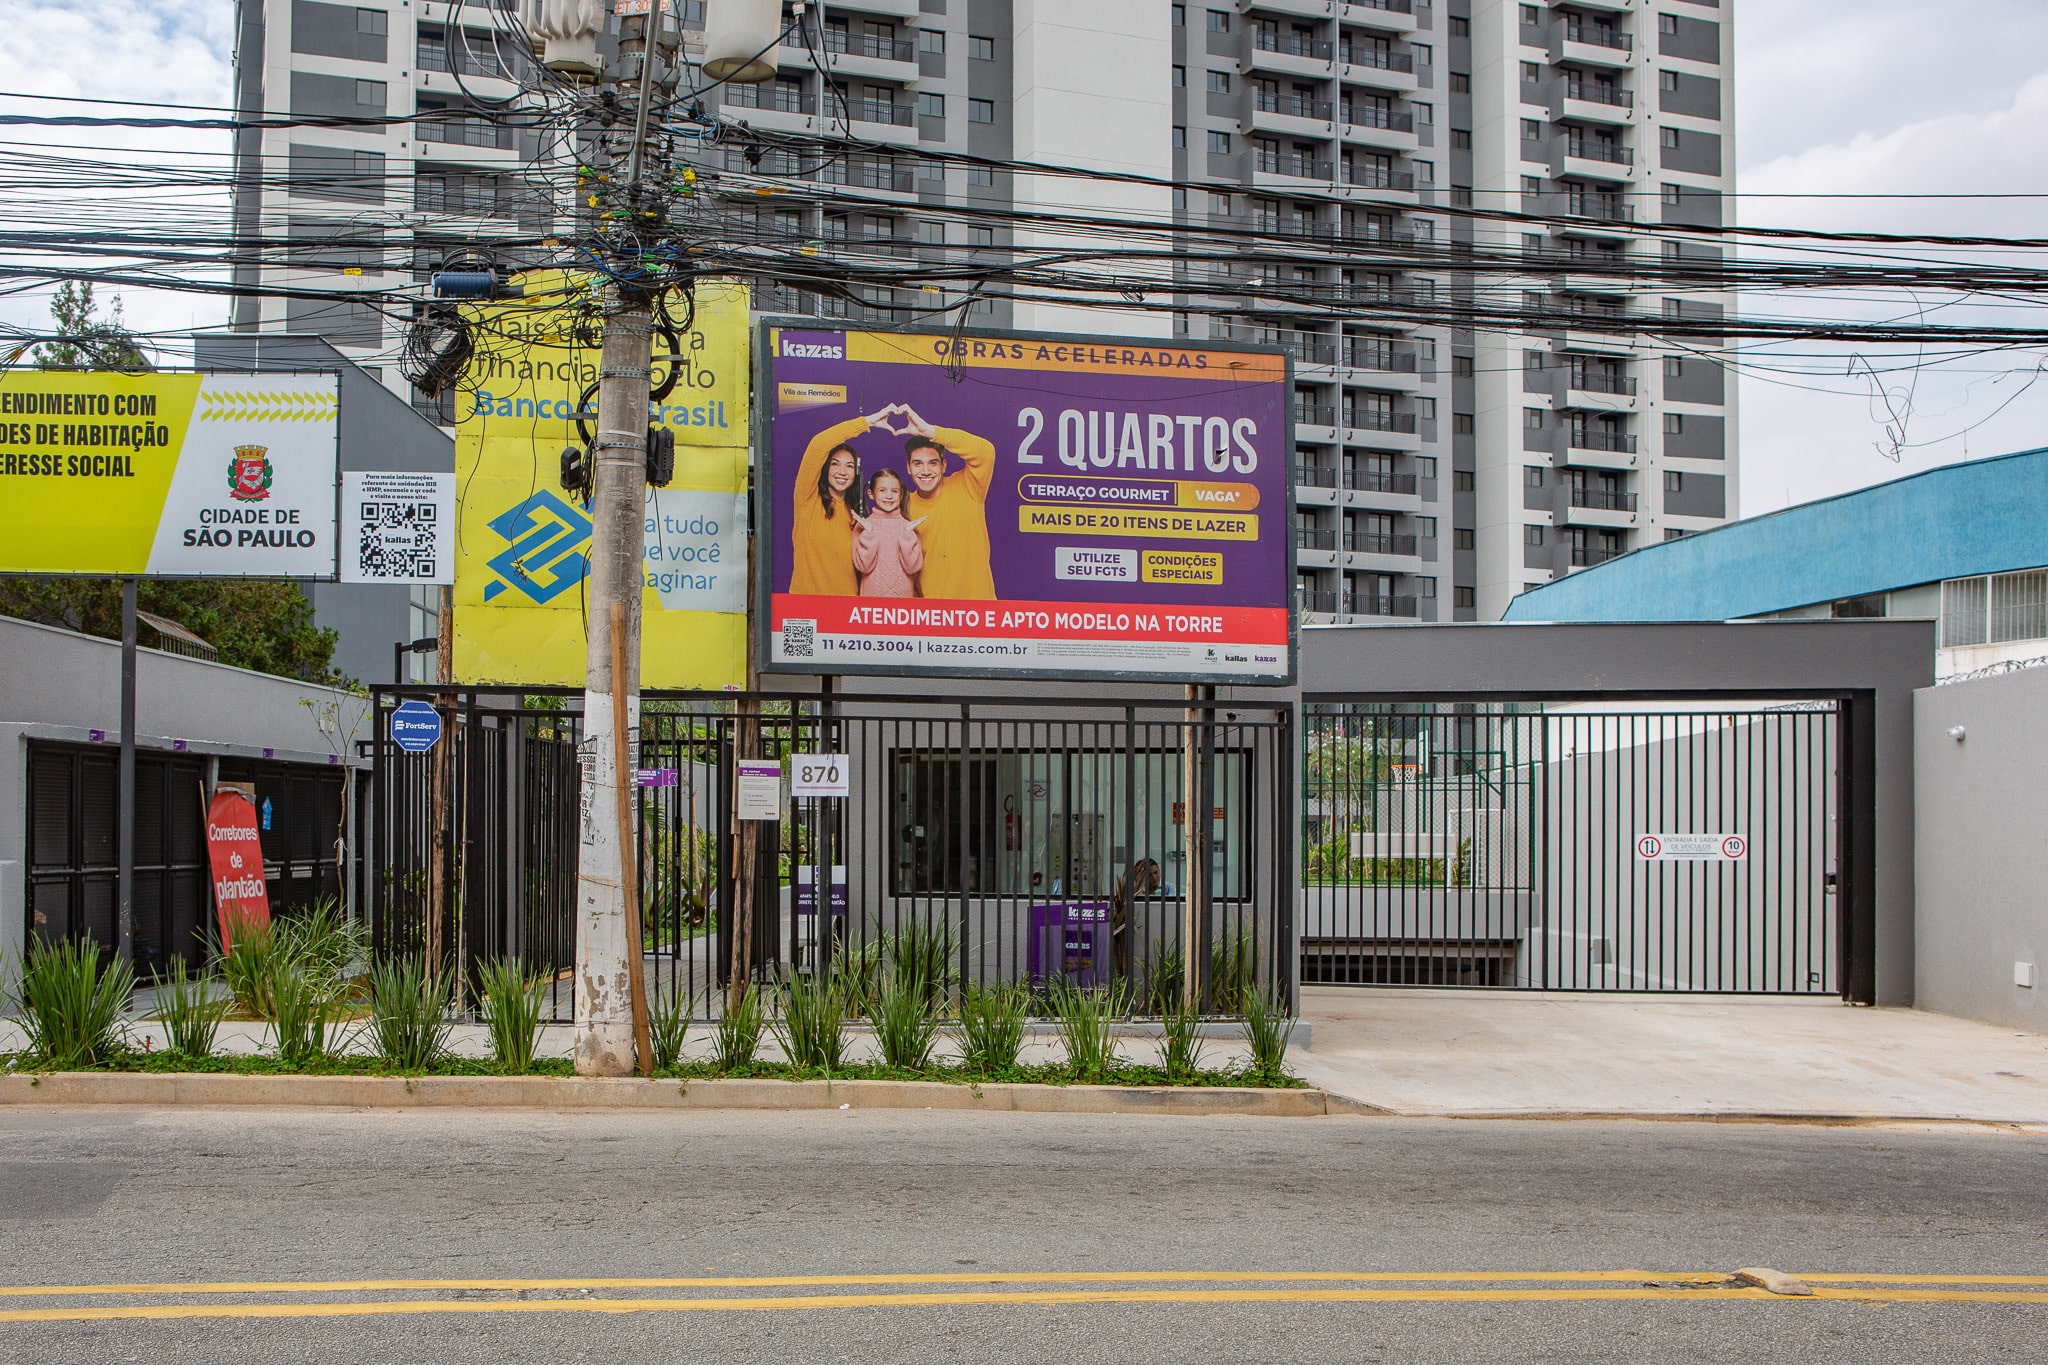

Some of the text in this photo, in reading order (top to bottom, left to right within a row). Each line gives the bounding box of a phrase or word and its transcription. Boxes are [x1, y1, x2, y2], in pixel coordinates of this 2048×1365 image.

[782, 339, 842, 359] kazzas
[933, 340, 1209, 370] OBRAS ACELERADAS
[475, 350, 598, 382] financia
[808, 388, 840, 397] Remédios
[0, 392, 156, 416] ENDIMENTO COM
[475, 390, 574, 420] Banco
[36, 424, 59, 445] DE
[64, 421, 168, 452] HABITAÇÃO
[1018, 407, 1258, 474] 2 QUARTOS
[68, 455, 135, 477] SOCIAL
[1028, 484, 1170, 501] TERRAÇO GOURMET
[200, 508, 300, 524] CIDADE DE
[664, 514, 719, 536] tudo
[1032, 512, 1246, 533] MAIS DE 20 ITENS DE LAZER
[183, 525, 316, 548] SÃO PAULO
[668, 542, 720, 562] você
[1073, 552, 1120, 564] UTILIZE
[1148, 554, 1217, 568] CONDIÇÕES
[642, 568, 718, 593] aginar
[1067, 565, 1126, 576] SEU FGTS
[1152, 569, 1213, 580] ESPECIAIS
[849, 606, 1223, 633] ATENDIMENTO E APTO MODELO NA TORRE
[822, 639, 834, 650] 11
[838, 640, 914, 652] 4210.3004
[928, 642, 1028, 655] kazzas.com.br
[802, 766, 839, 783] 870
[209, 823, 257, 841] Corretores
[1728, 841, 1740, 850] 10
[230, 851, 242, 868] de
[216, 874, 264, 908] plantão
